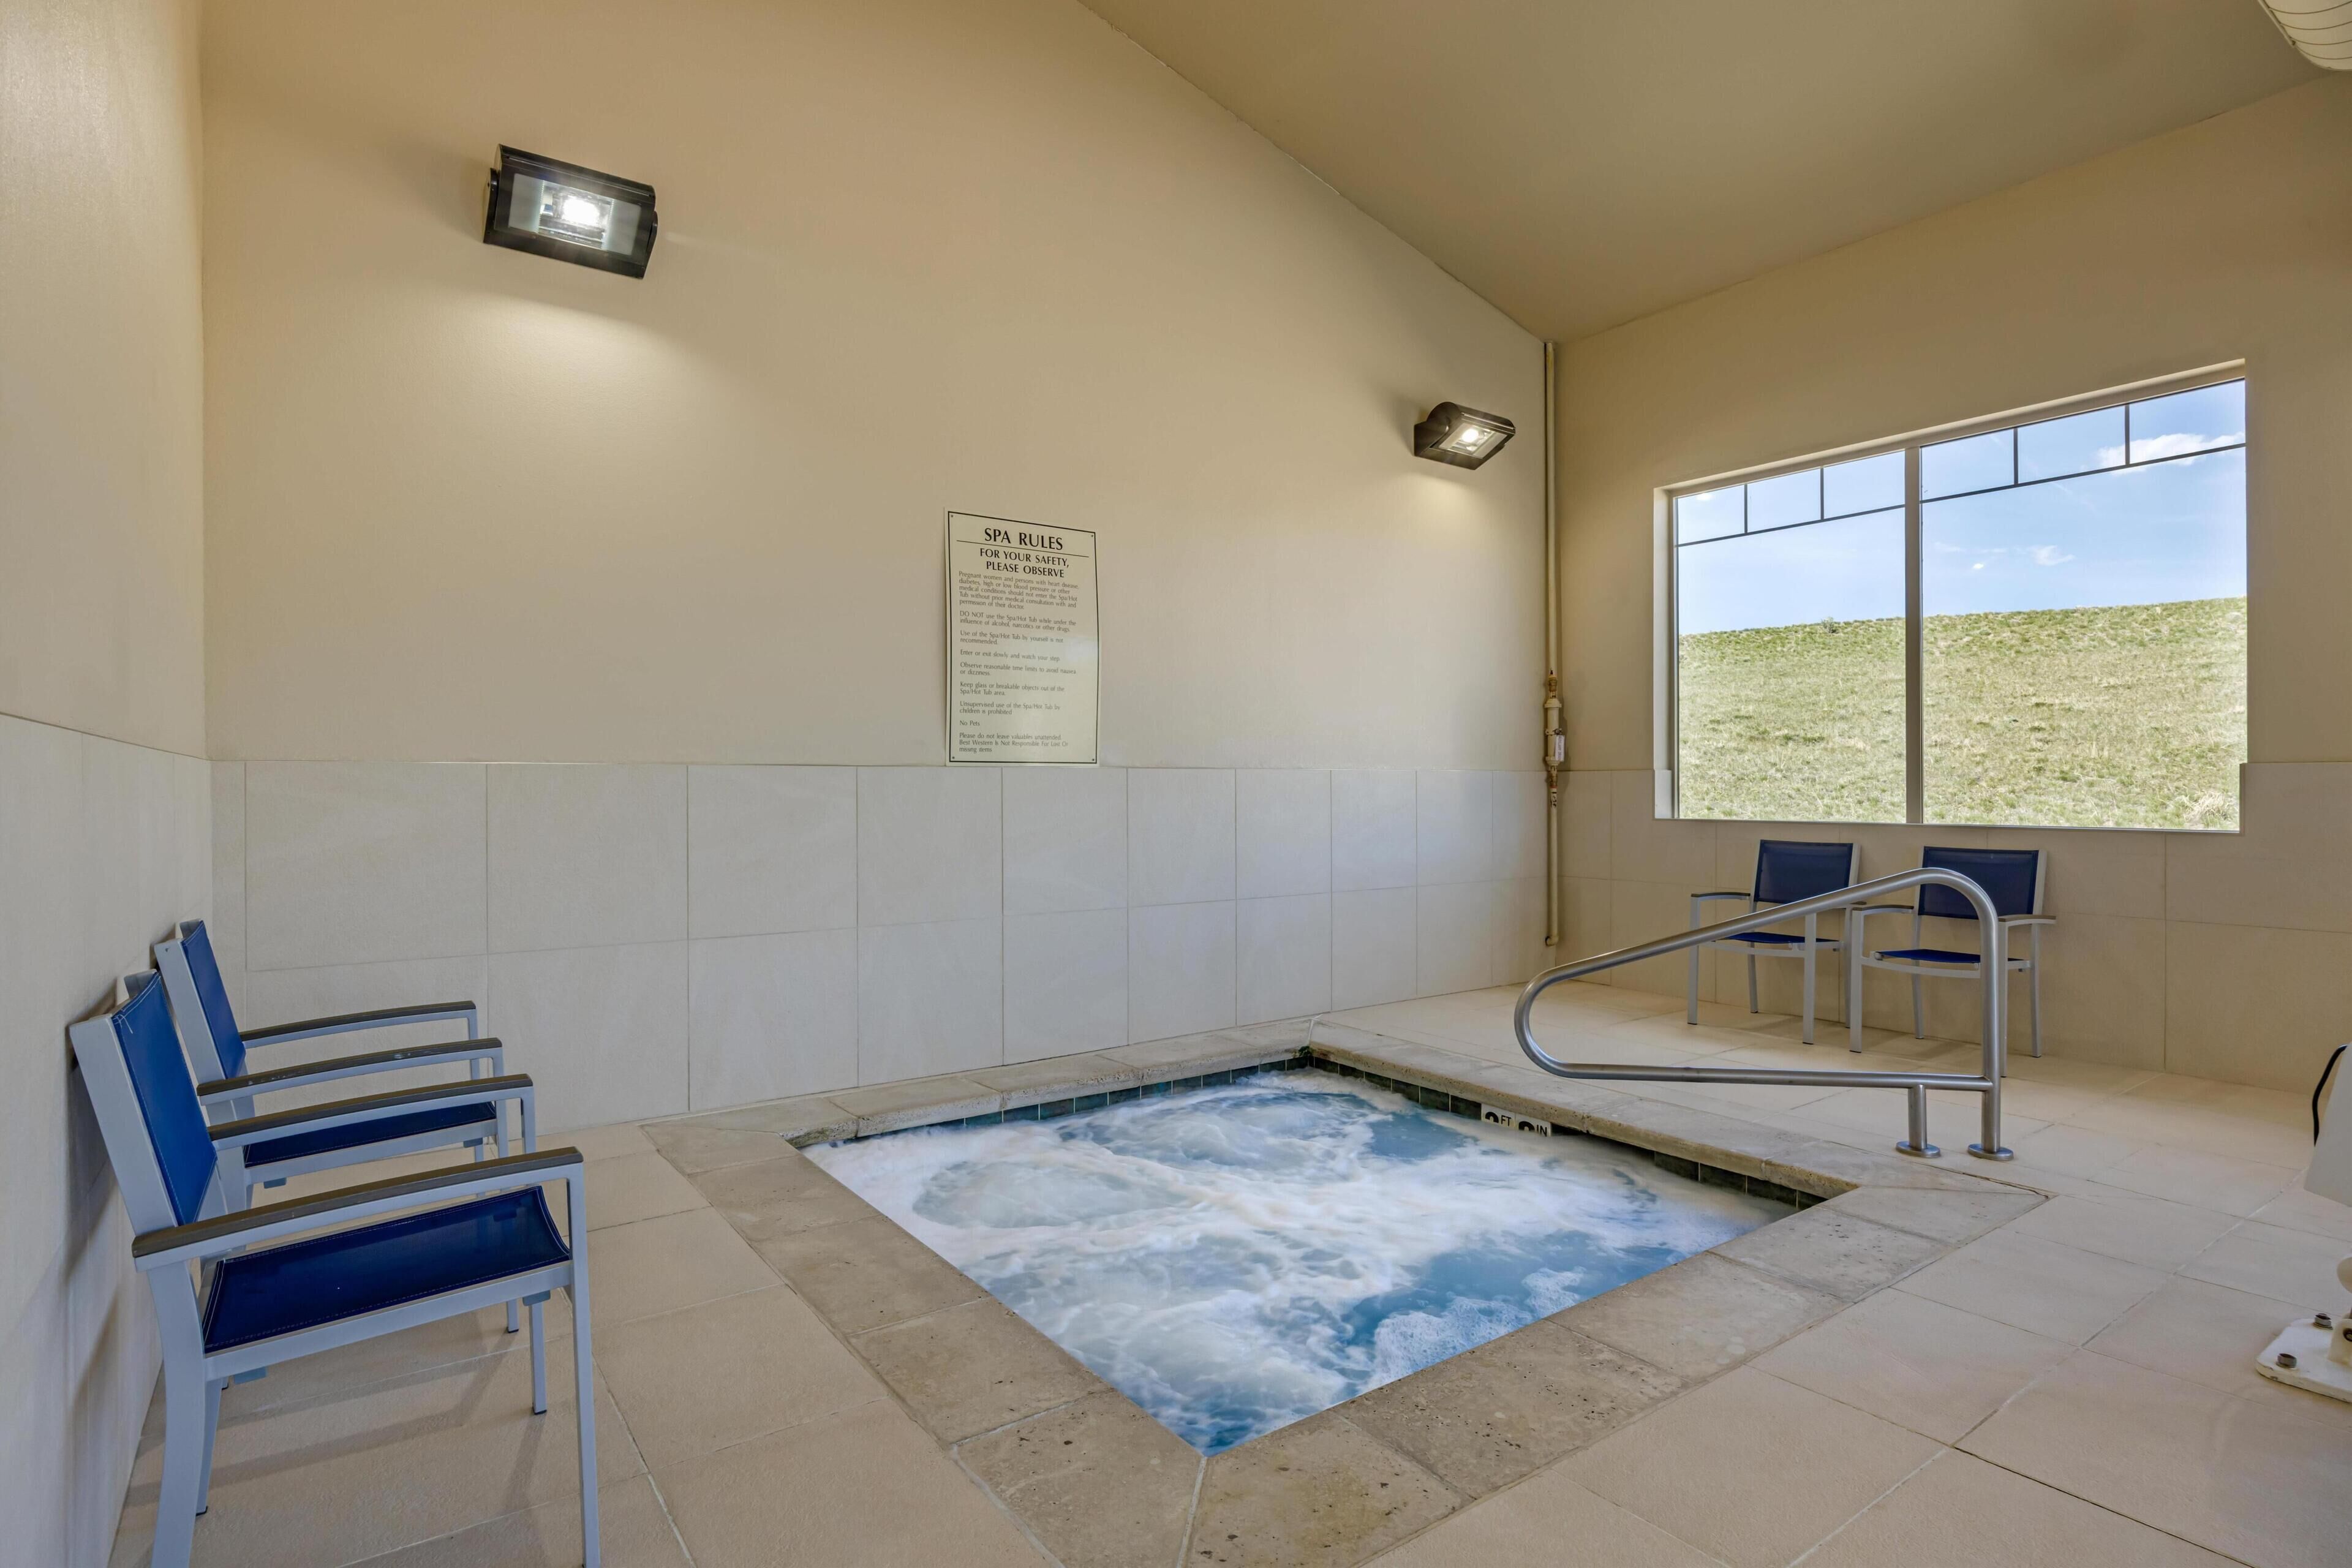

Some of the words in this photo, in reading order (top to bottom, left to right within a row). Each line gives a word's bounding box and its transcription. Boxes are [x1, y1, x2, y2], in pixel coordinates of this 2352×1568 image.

[984, 528, 1011, 543] SPA
[1019, 532, 1062, 549] RULES
[980, 548, 999, 558] FOR
[1004, 551, 1031, 562] YOUR
[1035, 555, 1068, 568] SAFETY,
[987, 561, 1018, 573] PLEASE
[1023, 565, 1063, 578] OBSERVE
[959, 570, 981, 579] Pregnant
[959, 597, 986, 607] permission
[992, 594, 1003, 602] prior
[1025, 597, 1054, 606] consultation
[1058, 594, 1077, 603] Spa/Hot
[1006, 614, 1026, 623] Spa/Hot
[989, 631, 1009, 640] Spa/Hot
[960, 700, 993, 709] Unsupervised
